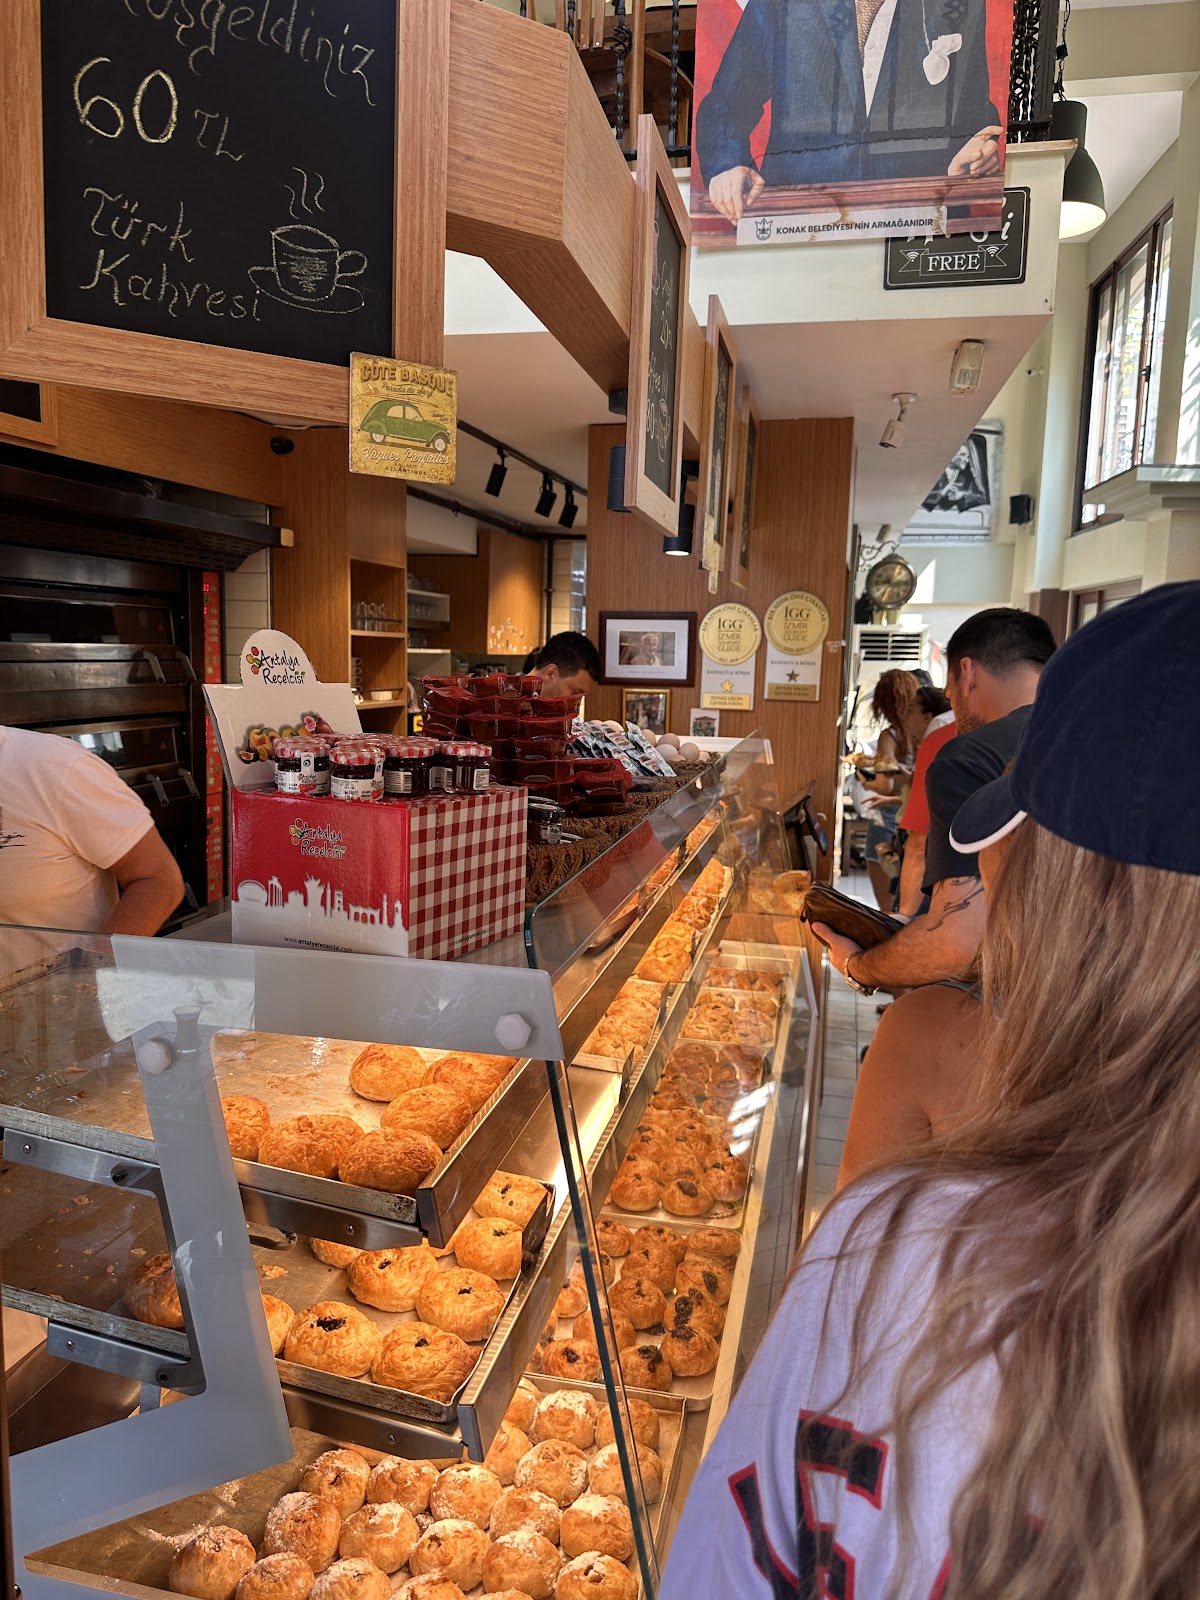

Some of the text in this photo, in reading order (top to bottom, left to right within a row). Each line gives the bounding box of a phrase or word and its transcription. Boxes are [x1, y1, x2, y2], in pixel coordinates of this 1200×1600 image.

[125, 0, 376, 107] oşgeldiniz
[73, 56, 246, 162] 60 TL
[83, 186, 196, 263] Türk
[776, 218, 934, 235] KONAK BELEDİYESİ'NİN ARMAĞANIDIR
[926, 253, 981, 272] FREE
[80, 249, 262, 322] Kahvesi
[361, 361, 454, 399] CÔTE BASQUE
[258, 650, 301, 672] Antalya
[299, 821, 344, 846] Antalya
